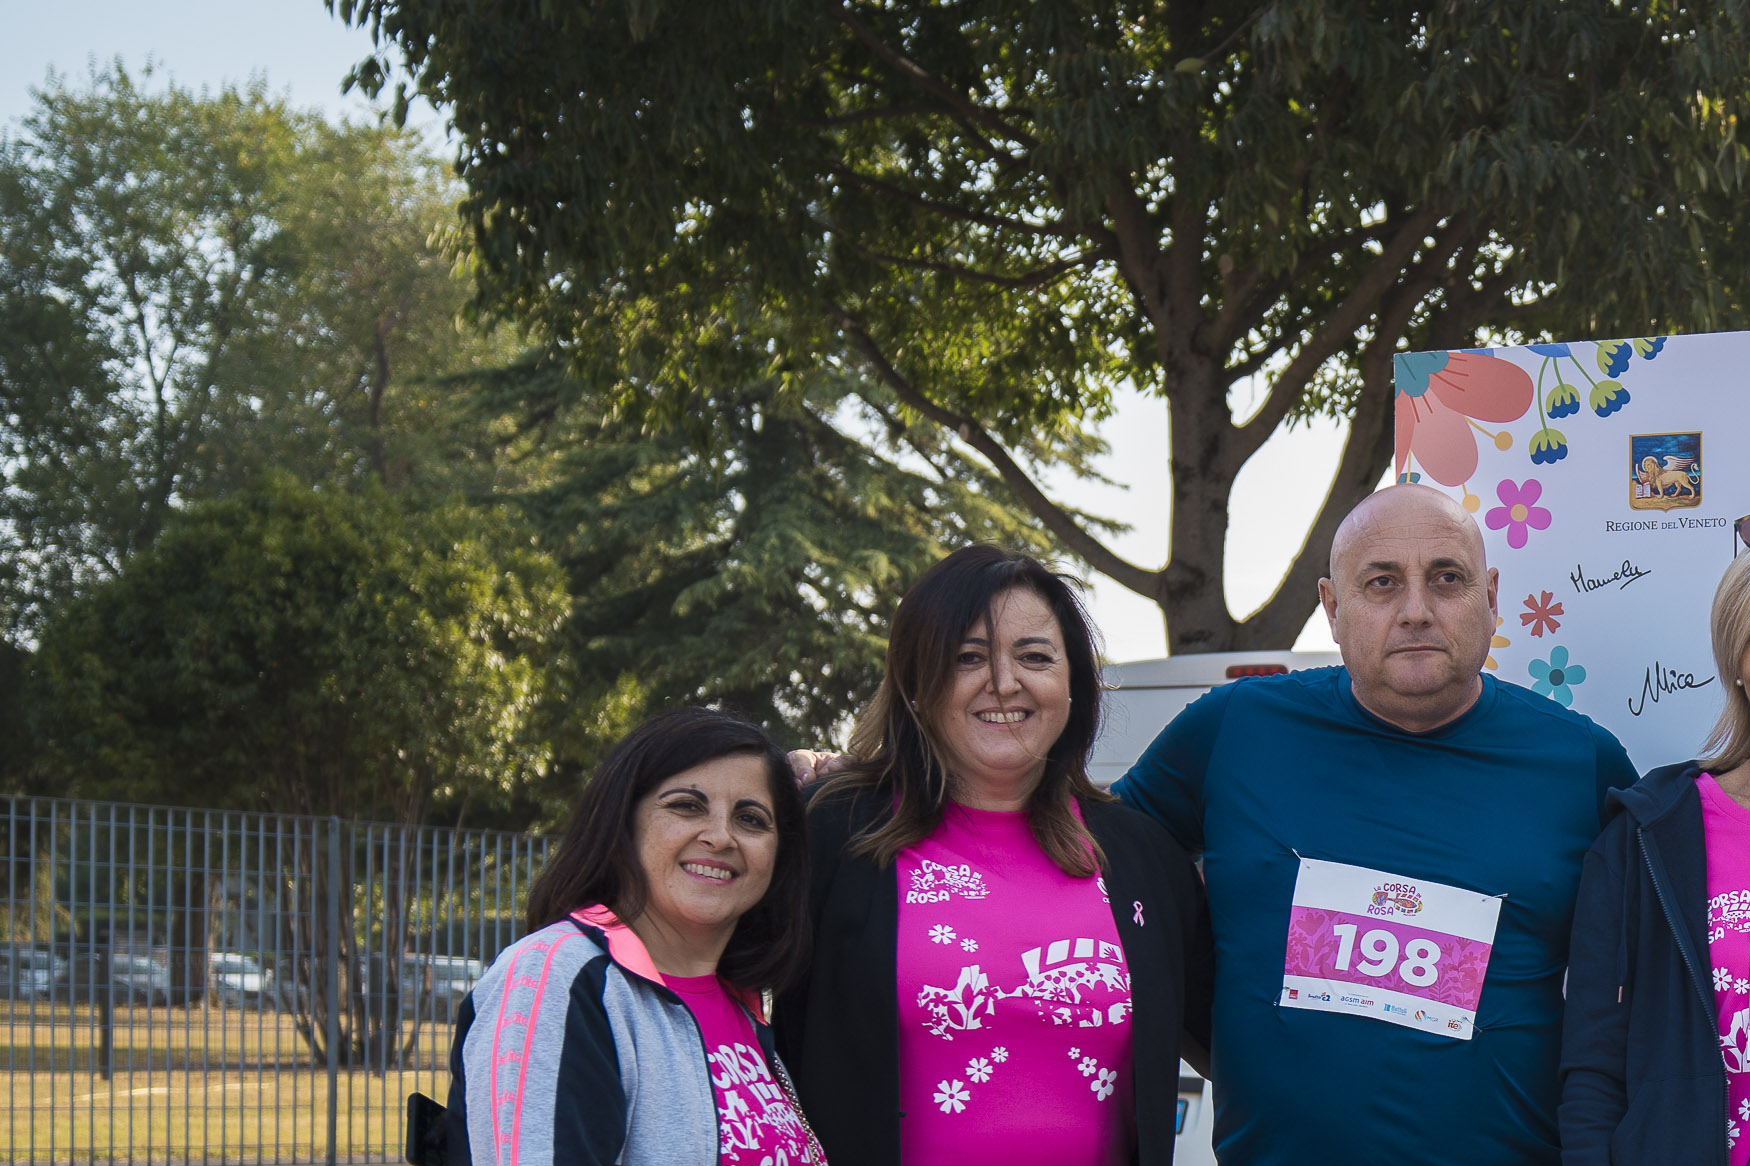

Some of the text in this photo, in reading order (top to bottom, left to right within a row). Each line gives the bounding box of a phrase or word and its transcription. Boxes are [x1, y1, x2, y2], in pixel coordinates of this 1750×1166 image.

[1605, 520, 1658, 532] REGIONE
[1679, 517, 1727, 529] VENETO
[1383, 882, 1417, 895] CORSA
[905, 889, 950, 904] ROSA
[1367, 903, 1394, 916] ROSA
[1708, 926, 1725, 944] SA
[1333, 923, 1442, 988] 198
[708, 1042, 771, 1089] CORSA
